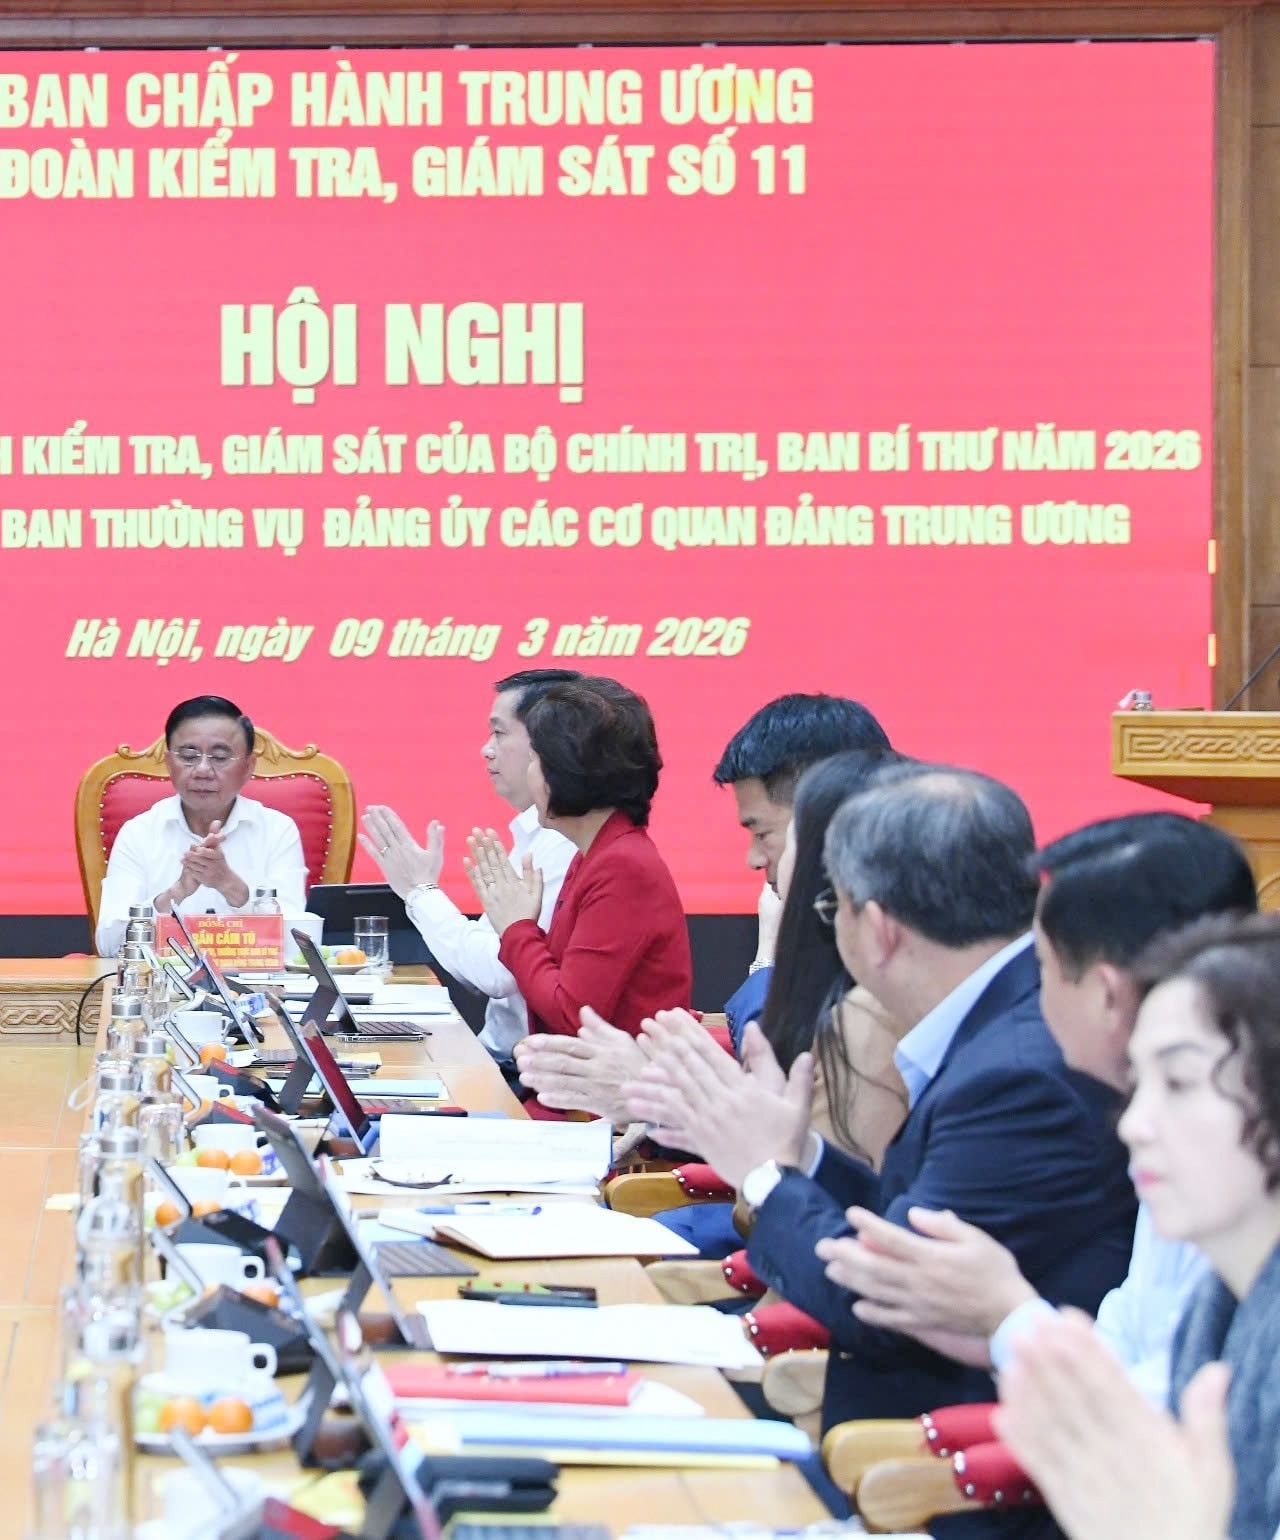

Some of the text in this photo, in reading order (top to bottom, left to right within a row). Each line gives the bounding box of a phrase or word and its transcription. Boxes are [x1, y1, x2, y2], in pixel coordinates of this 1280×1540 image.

[125, 53, 274, 127] CHẤP
[291, 60, 443, 127] HÀNH
[458, 69, 643, 127] TRUNG
[660, 63, 813, 125] ƯƠNG
[148, 128, 276, 199] KIỂM
[289, 147, 398, 204] TRA,
[412, 136, 544, 197] GIÁM
[558, 135, 655, 196] SÁT
[667, 127, 738, 195] SỐ
[751, 145, 806, 195] 11
[221, 286, 584, 405] HỘI NGHỊ
[22, 420, 121, 475] KIỂM
[129, 435, 213, 480] TRA,
[222, 427, 324, 475] GIÁM
[333, 427, 408, 475] SÁT
[416, 422, 496, 475] CỦA
[504, 426, 558, 483] BỘ
[566, 426, 687, 474] CHÍNH
[695, 433, 769, 481] TRỊ,
[777, 431, 861, 473] BAN
[868, 423, 912, 472] BÍ
[917, 427, 999, 472] THƯ
[1002, 422, 1097, 471] NĂM
[1104, 430, 1202, 471] 2026
[1, 508, 83, 549] BAN
[90, 500, 244, 549] THƯỜNG
[252, 508, 304, 557] VỤ
[323, 495, 431, 548] ĐẢNG
[440, 495, 492, 548] ỦY
[500, 500, 580, 548] CÁC
[588, 503, 644, 548] CƠ
[651, 505, 757, 551] QUAN
[764, 493, 874, 547] ĐẢNG
[882, 504, 1013, 546] TRUNG
[1021, 500, 1131, 546] ƯƠNG
[65, 616, 751, 666] Hà Nội, ngày 09 tháng 3 năm 2026
